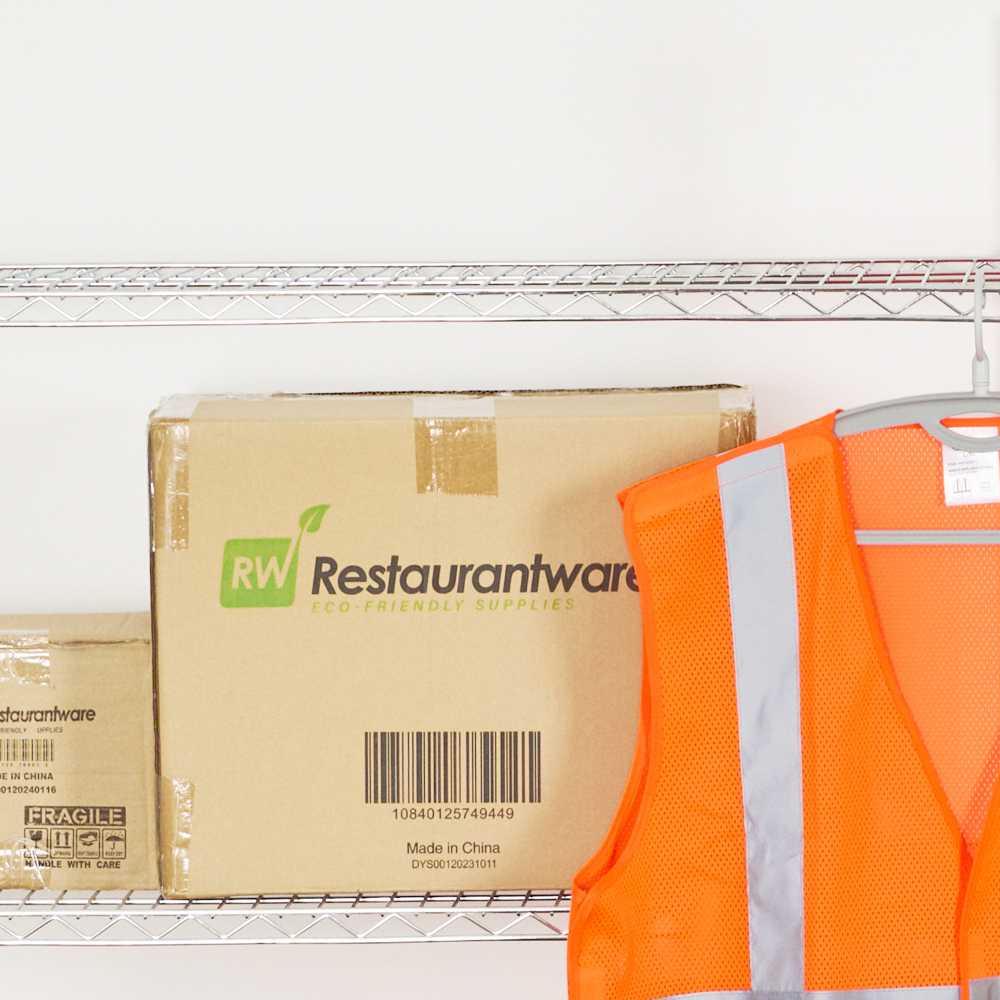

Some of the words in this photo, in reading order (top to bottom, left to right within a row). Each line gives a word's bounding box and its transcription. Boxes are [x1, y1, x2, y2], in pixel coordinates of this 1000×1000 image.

[231, 555, 292, 590] RW
[311, 599, 464, 614] ECO-FRIENDLY
[475, 598, 576, 611] SUPPLIES
[11, 772, 21, 780] IN
[24, 772, 54, 780] CHINA
[28, 807, 123, 825] FRAGILE
[392, 807, 514, 820] 10840125749449
[407, 842, 443, 854] Made
[447, 842, 458, 853] in
[462, 842, 500, 854] China
[96, 861, 121, 869] CARE
[412, 859, 496, 869] DYS00120231011
